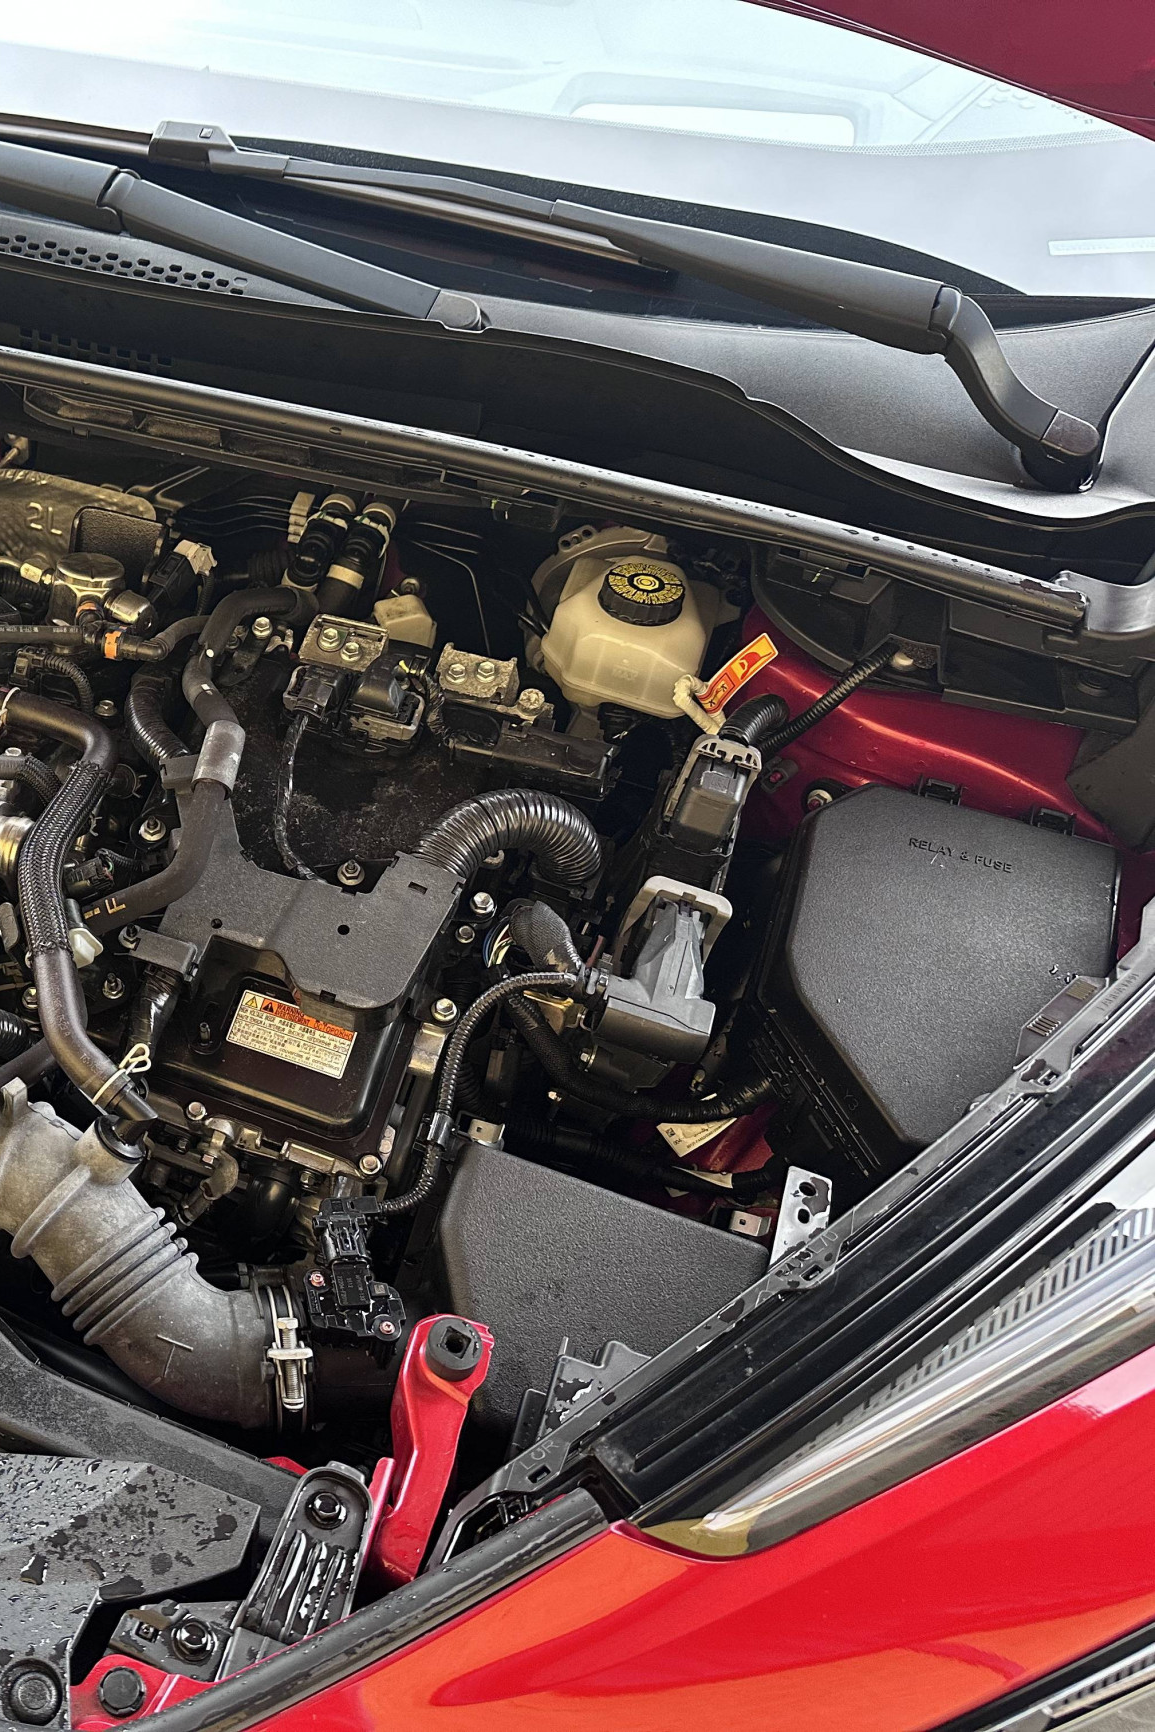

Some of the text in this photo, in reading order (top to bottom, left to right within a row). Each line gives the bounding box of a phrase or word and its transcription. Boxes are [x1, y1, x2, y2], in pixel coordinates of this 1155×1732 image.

[908, 837, 1013, 873] RELAY & FUSE
[277, 1003, 304, 1017] WARNING
